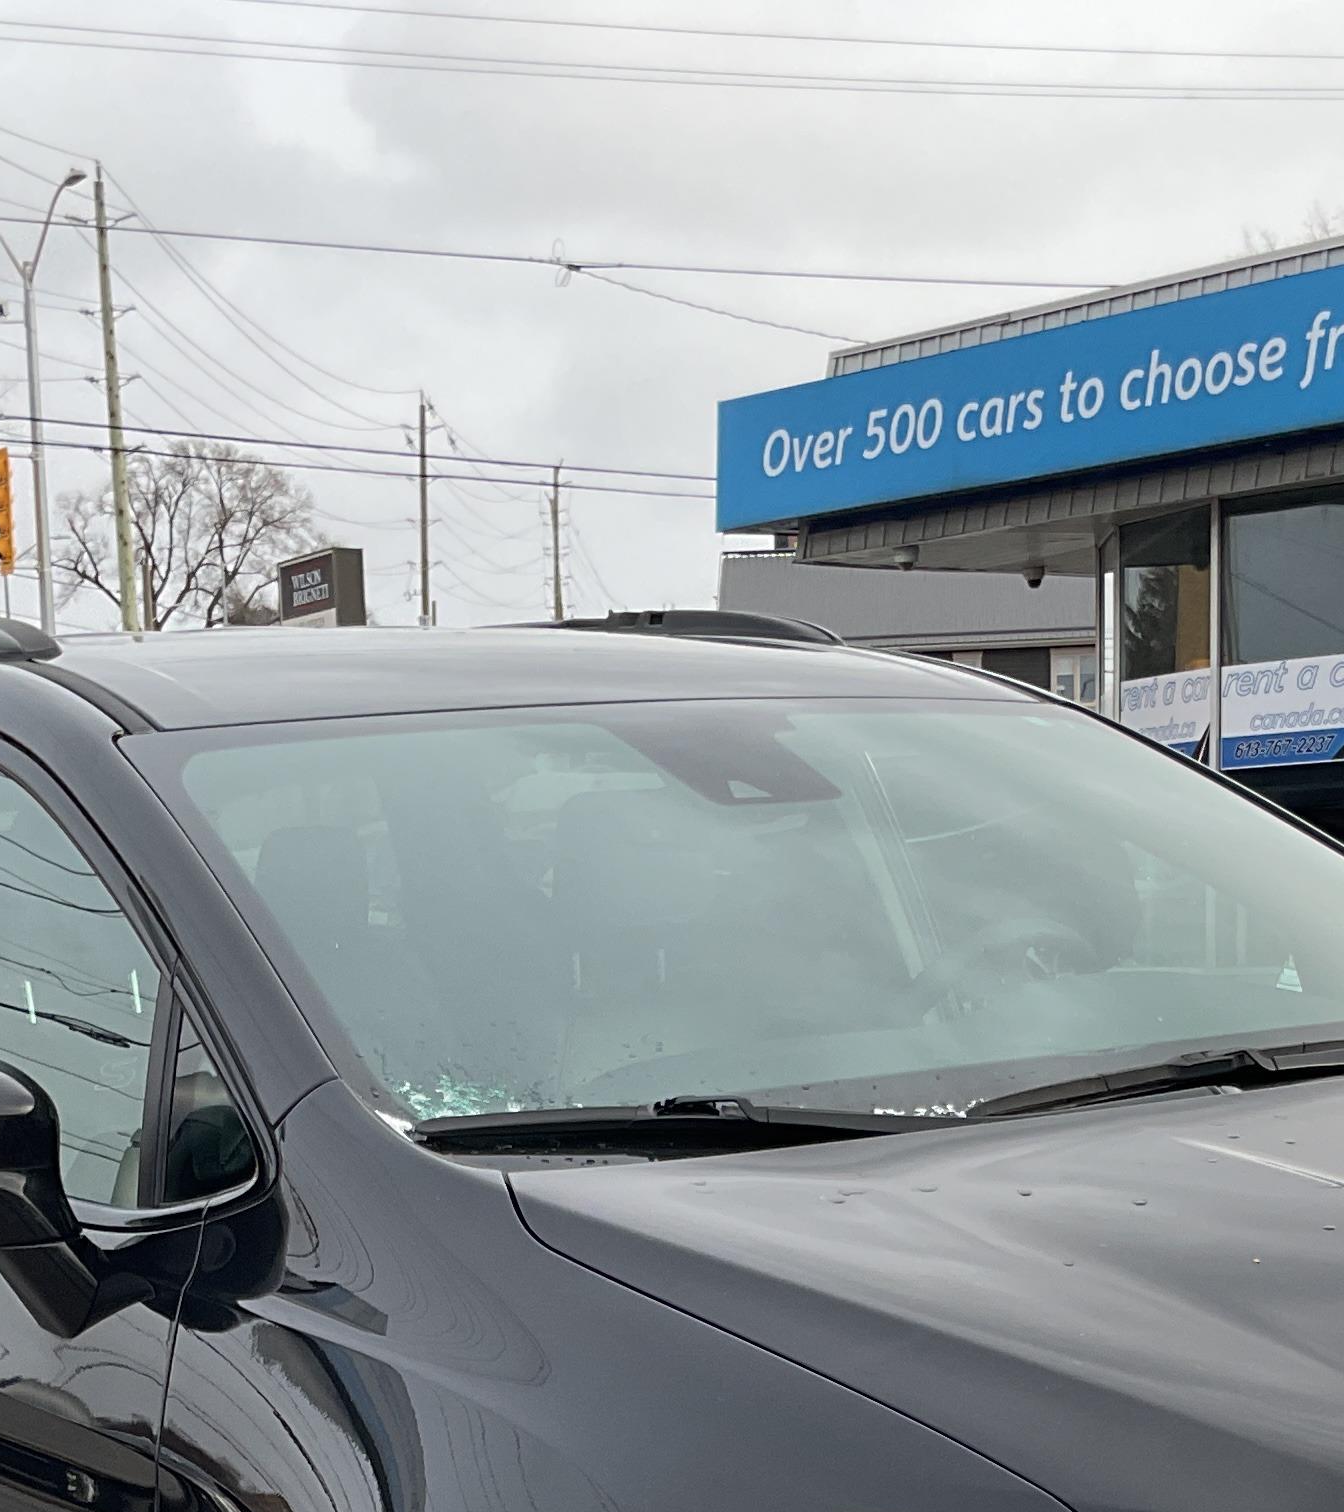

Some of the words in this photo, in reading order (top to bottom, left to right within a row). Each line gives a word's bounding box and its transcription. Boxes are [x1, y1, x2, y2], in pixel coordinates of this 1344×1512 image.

[762, 426, 853, 477] Over
[862, 399, 944, 460] 500
[957, 388, 1045, 442] cars
[1059, 371, 1105, 423] to
[1120, 337, 1288, 411] choose
[1120, 678, 1158, 712] rent
[1163, 681, 1176, 706] a
[1222, 660, 1289, 698] rent
[1296, 665, 1319, 691] a
[1234, 733, 1338, 760] 613-767-2237
